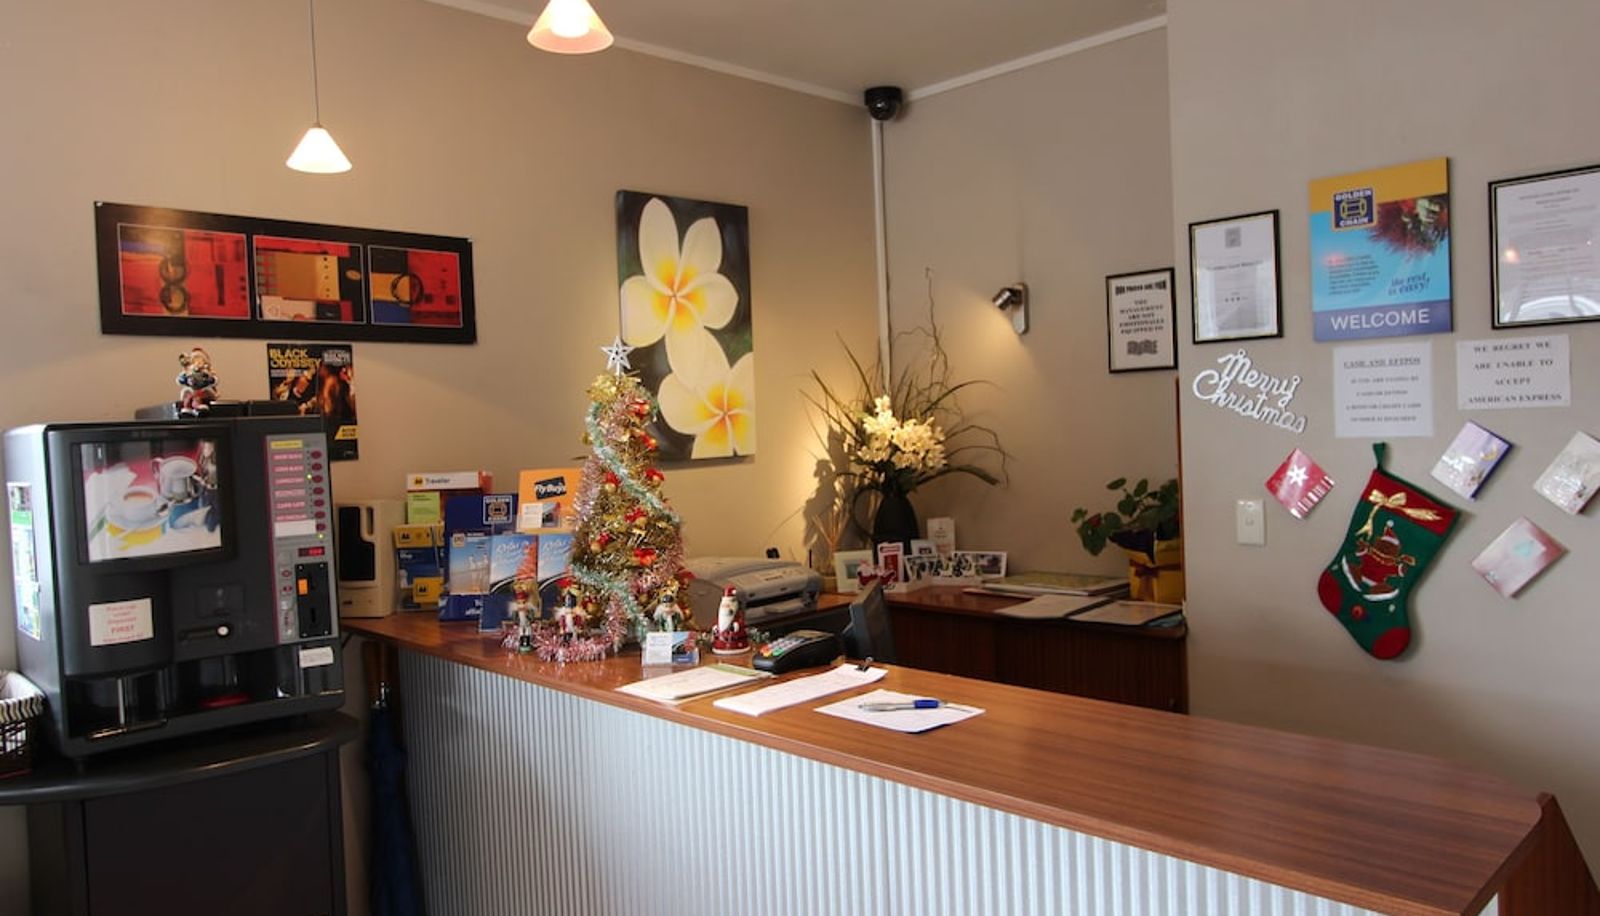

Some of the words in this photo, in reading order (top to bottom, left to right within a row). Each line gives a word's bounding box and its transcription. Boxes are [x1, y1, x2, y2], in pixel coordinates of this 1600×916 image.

[1331, 308, 1430, 331] WELCOME
[1492, 343, 1531, 352] REGRET
[1535, 341, 1549, 349] WE
[269, 348, 309, 359] BLACK
[270, 358, 321, 369] ODYSSEY
[1474, 362, 1491, 370] ARE
[1496, 360, 1533, 369] UNABLE
[1217, 349, 1301, 408] Merry
[1495, 377, 1531, 386] ACCEPT
[1192, 369, 1306, 434] Christmas
[1469, 396, 1517, 404] AMERICAN
[1519, 393, 1562, 402] EXPRESS
